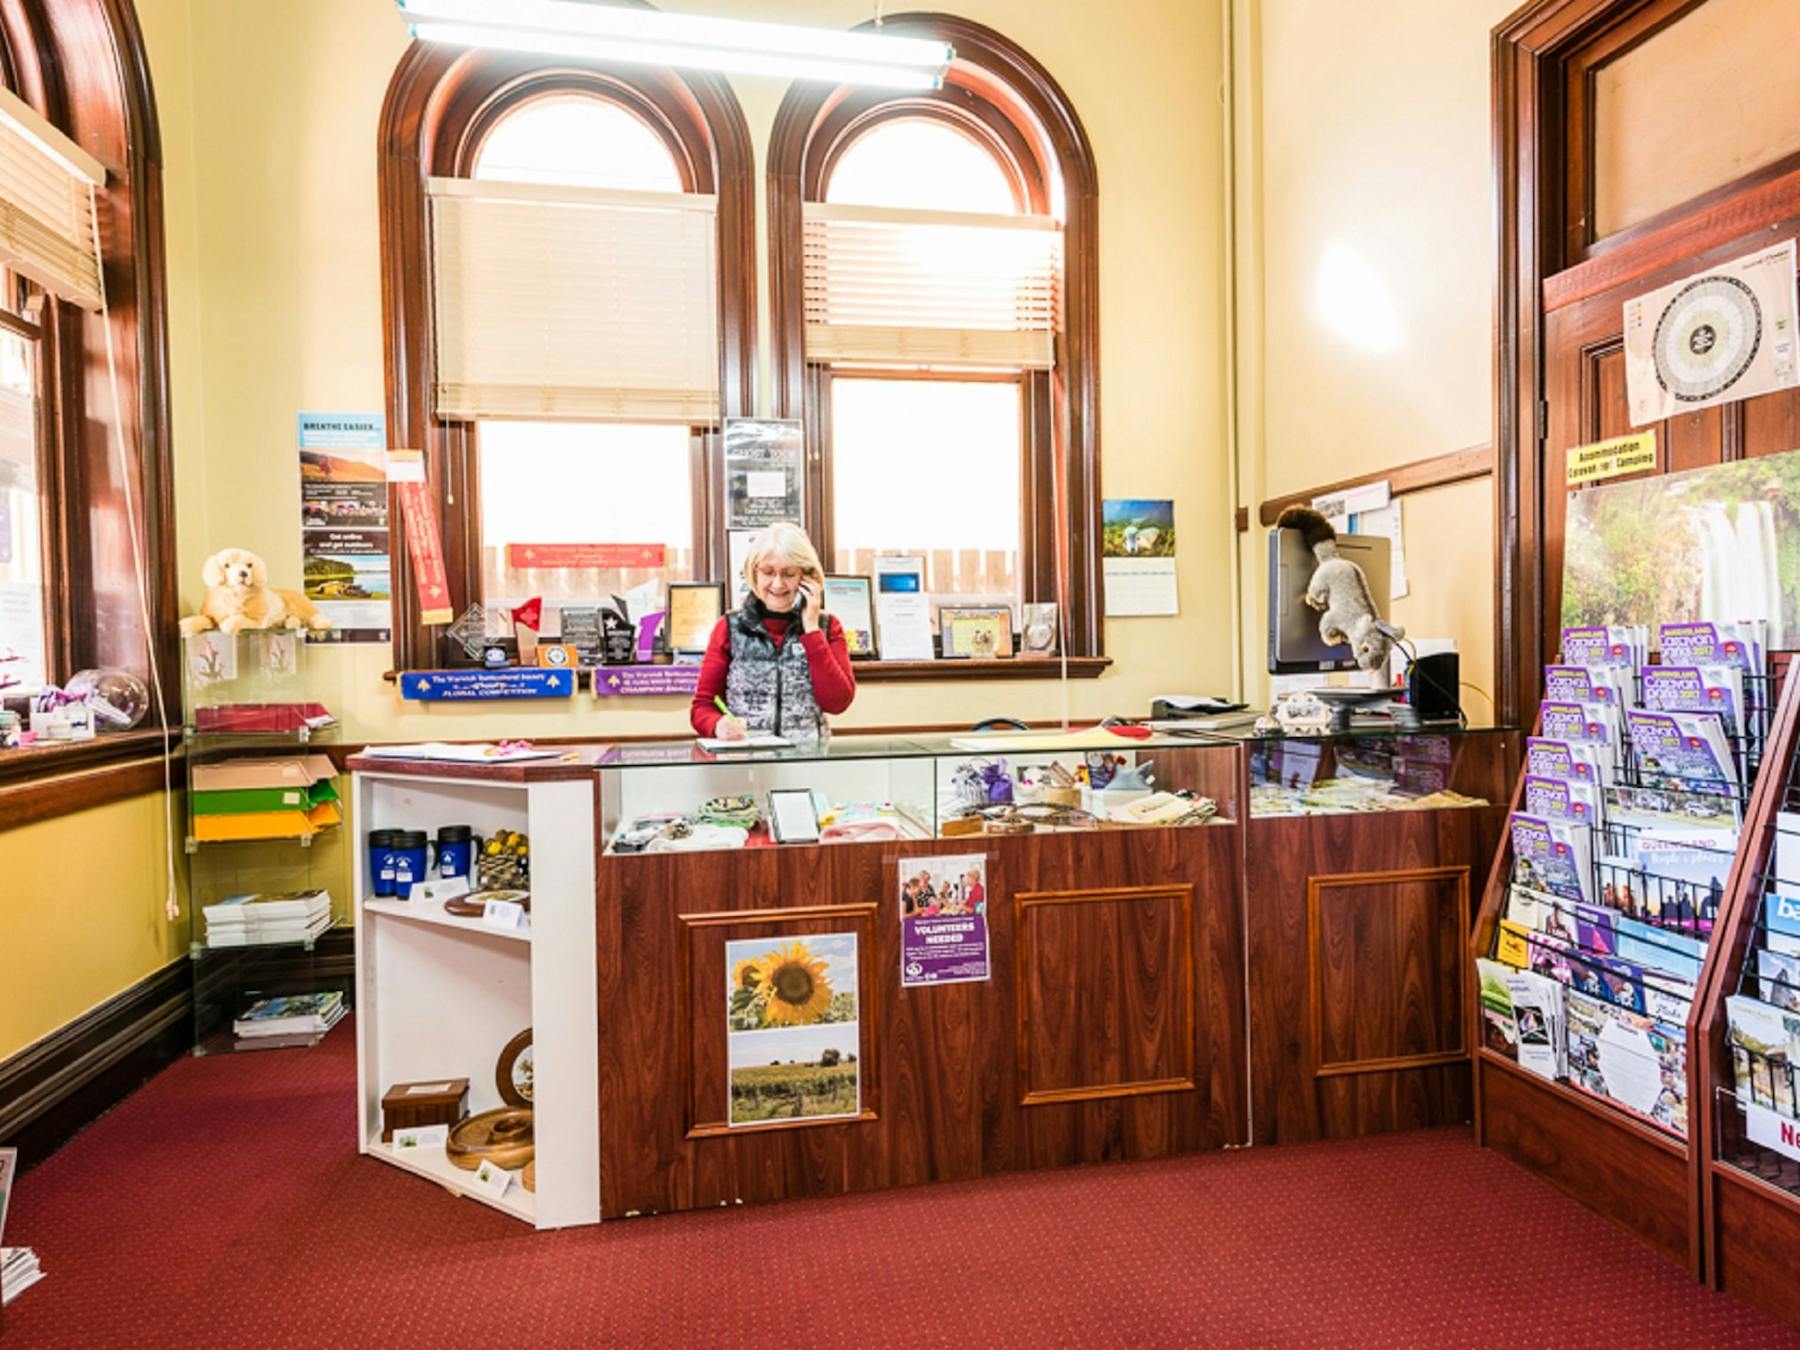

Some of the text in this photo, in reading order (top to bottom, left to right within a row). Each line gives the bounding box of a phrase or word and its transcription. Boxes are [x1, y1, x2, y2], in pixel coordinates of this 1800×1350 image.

[304, 423, 341, 431] BREATHE
[915, 922, 975, 934] VOLUNTEERS
[926, 933, 963, 944] NEEDED
